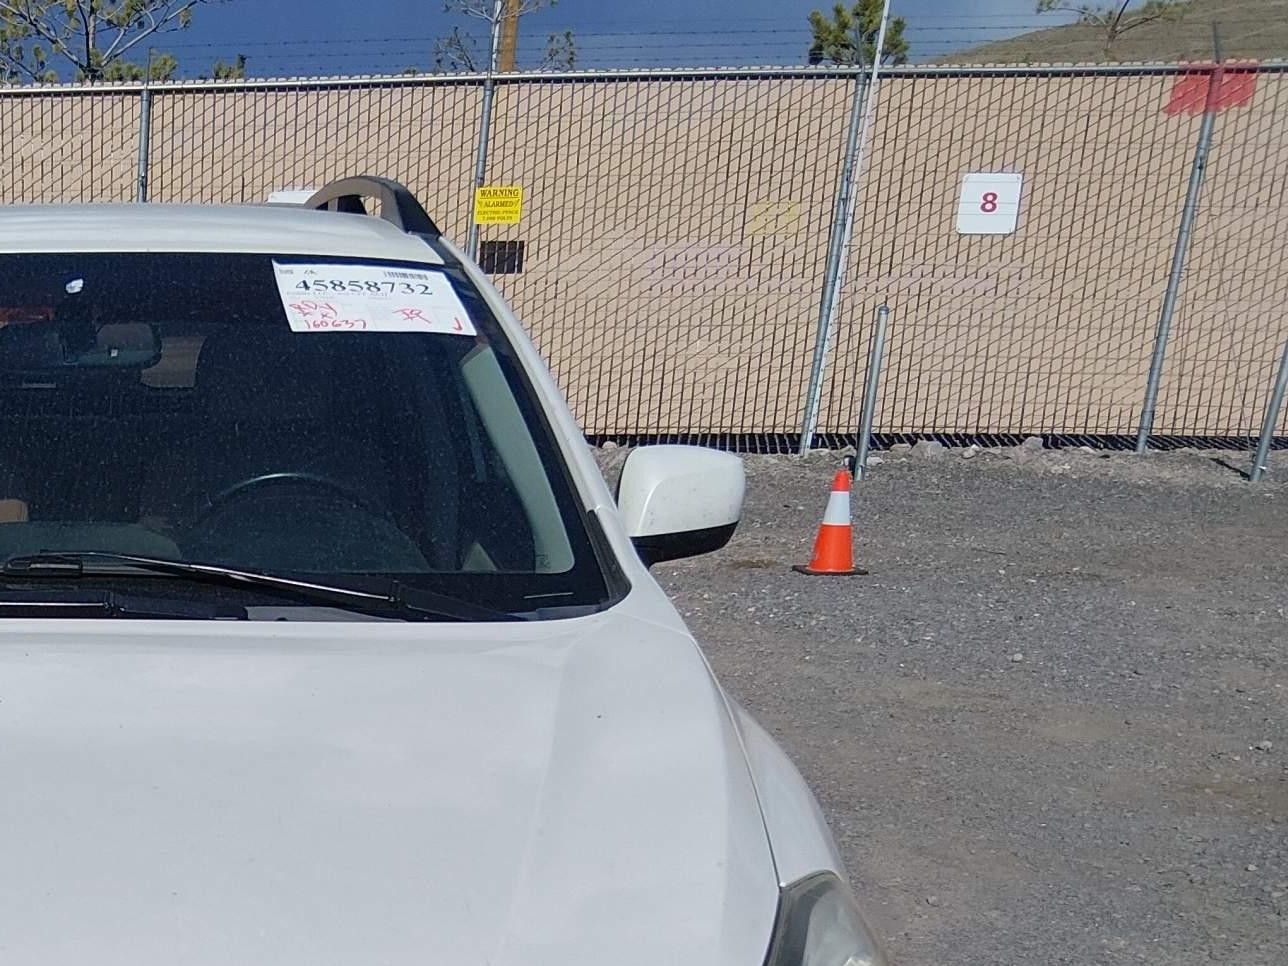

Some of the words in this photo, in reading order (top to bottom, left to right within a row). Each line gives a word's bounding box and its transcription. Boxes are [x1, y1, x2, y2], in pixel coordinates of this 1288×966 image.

[480, 189, 518, 197] WARNING
[980, 192, 998, 213] 8
[295, 279, 433, 296] 45858732
